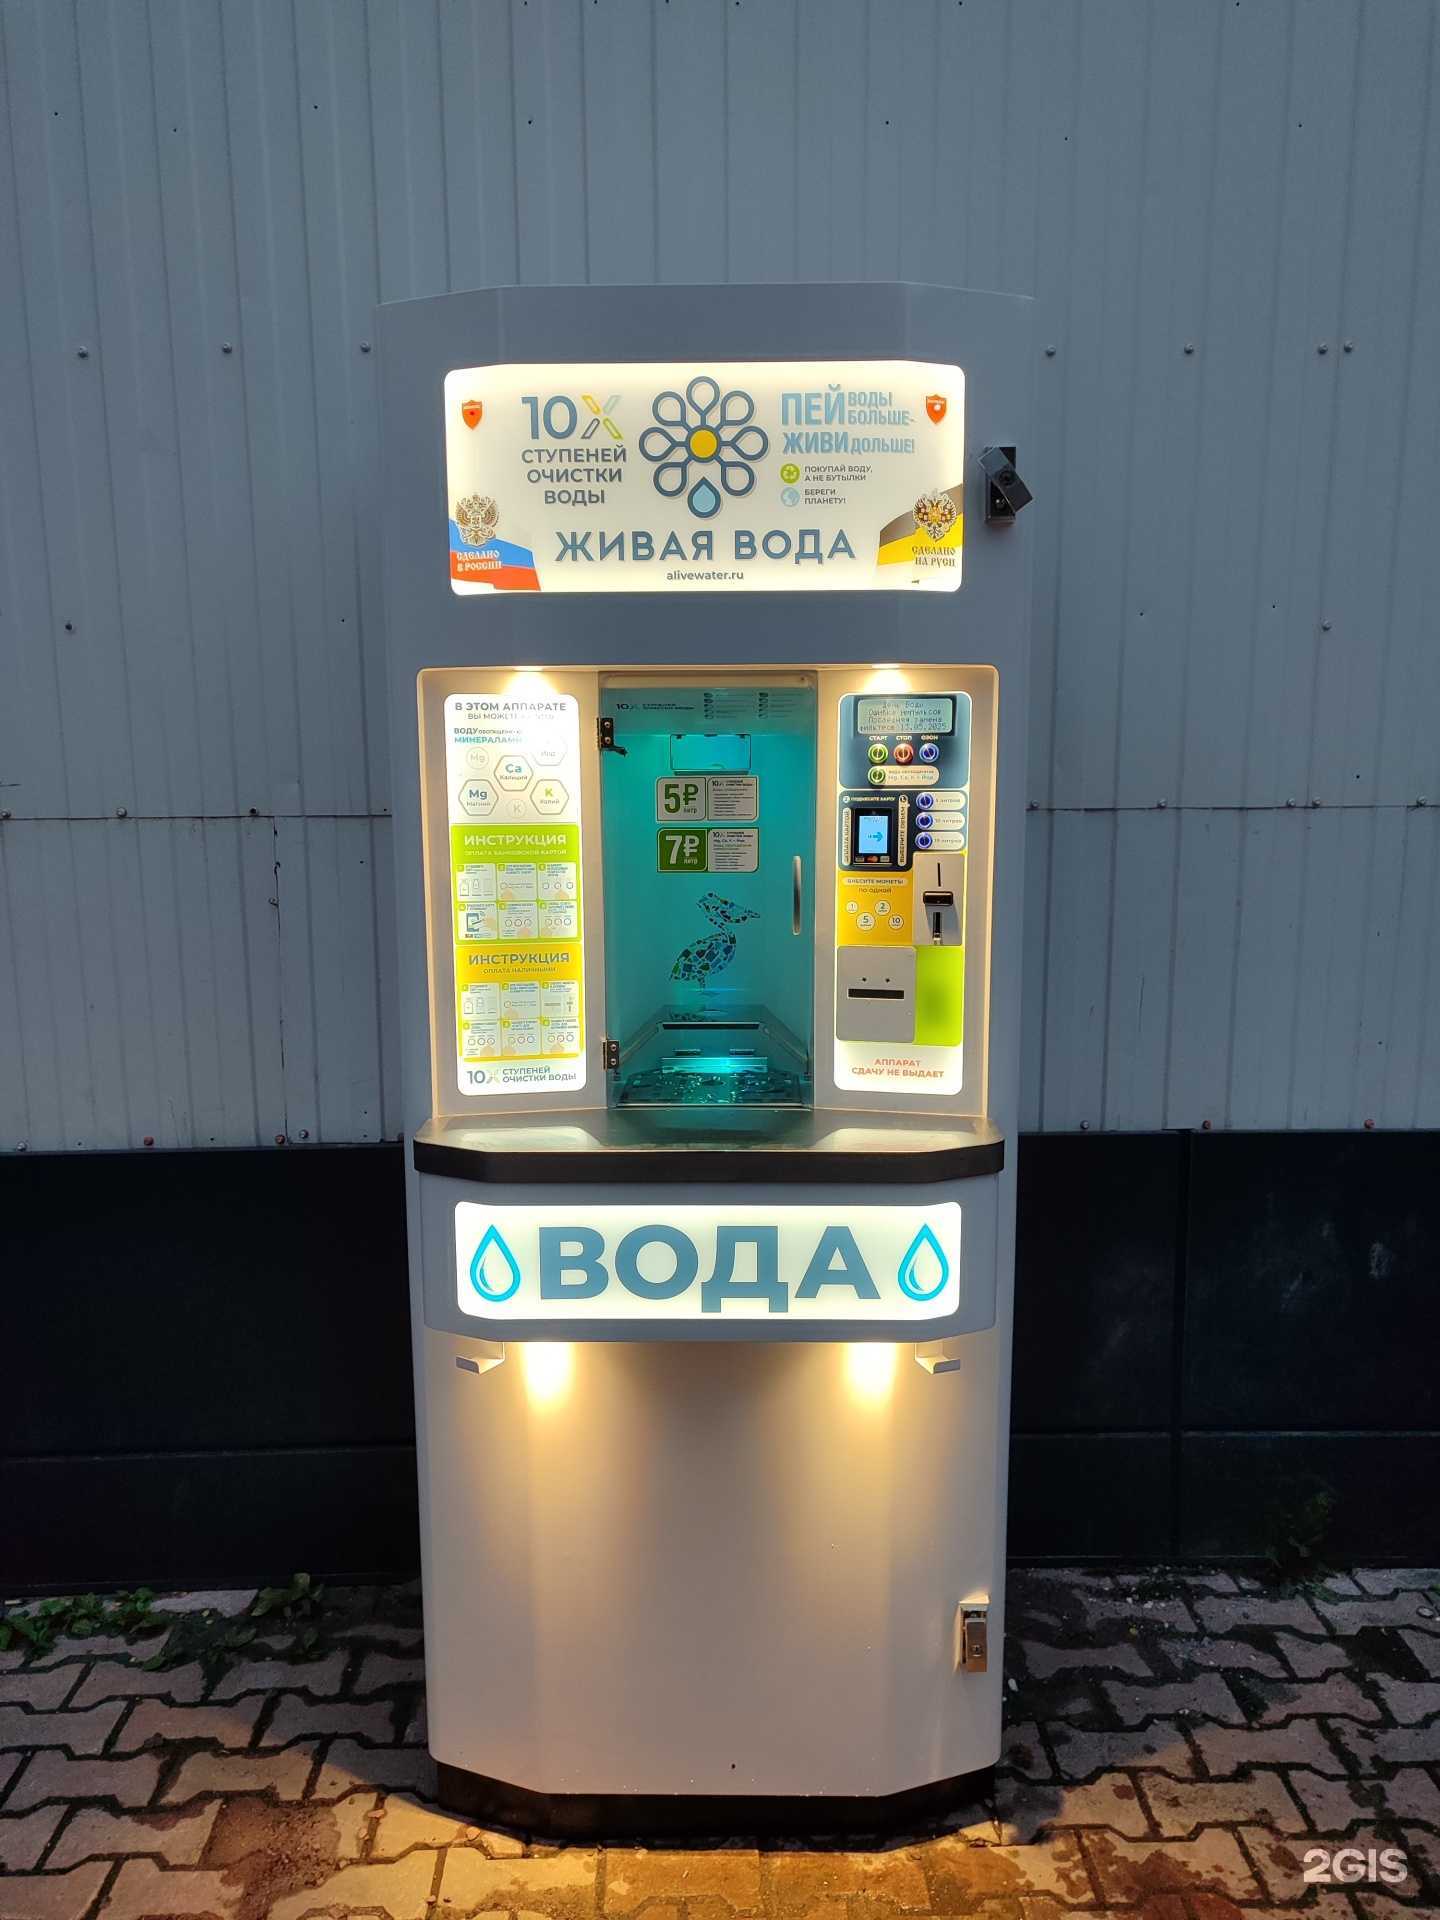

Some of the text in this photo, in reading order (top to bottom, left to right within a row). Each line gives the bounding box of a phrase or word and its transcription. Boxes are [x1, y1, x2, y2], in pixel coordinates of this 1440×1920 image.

[781, 384, 892, 426] ПЕЙ ВОДЫ
[782, 432, 915, 454] ЖИВИ ДОЛЬШЕ!
[522, 444, 626, 464] СТУПЕНЕЙ
[804, 465, 873, 474] ПОКУПАЙ ВОДУ,
[527, 468, 622, 483] ОЧИСТКИ
[825, 474, 867, 482] БУТЫЛКИ
[544, 490, 605, 506] ВОДЫ
[804, 497, 846, 505] ПЛАНЕТУ!
[555, 529, 856, 564] ЖИВАЯ ВОДА
[667, 570, 744, 580] alivewater.ru
[455, 702, 567, 711] В ЭТОМ АППАРАТЕ
[454, 727, 478, 735] ВОДУ
[505, 764, 522, 773] Ca
[469, 789, 488, 800] Mg
[464, 834, 567, 846] ИНСТРУКЦИЯ
[863, 915, 869, 923] 5
[468, 953, 570, 965] ИНСТРУКЦИЯ
[874, 1058, 921, 1067] АППАРАТ
[502, 1065, 551, 1075] СТУПЕНЕЙ
[851, 1066, 945, 1079] СДАЧУ НЕ ВЫДАЕТ
[502, 1073, 577, 1083] ОЧИСТКИ ВОДЫ
[538, 1224, 881, 1313] ВОДА
